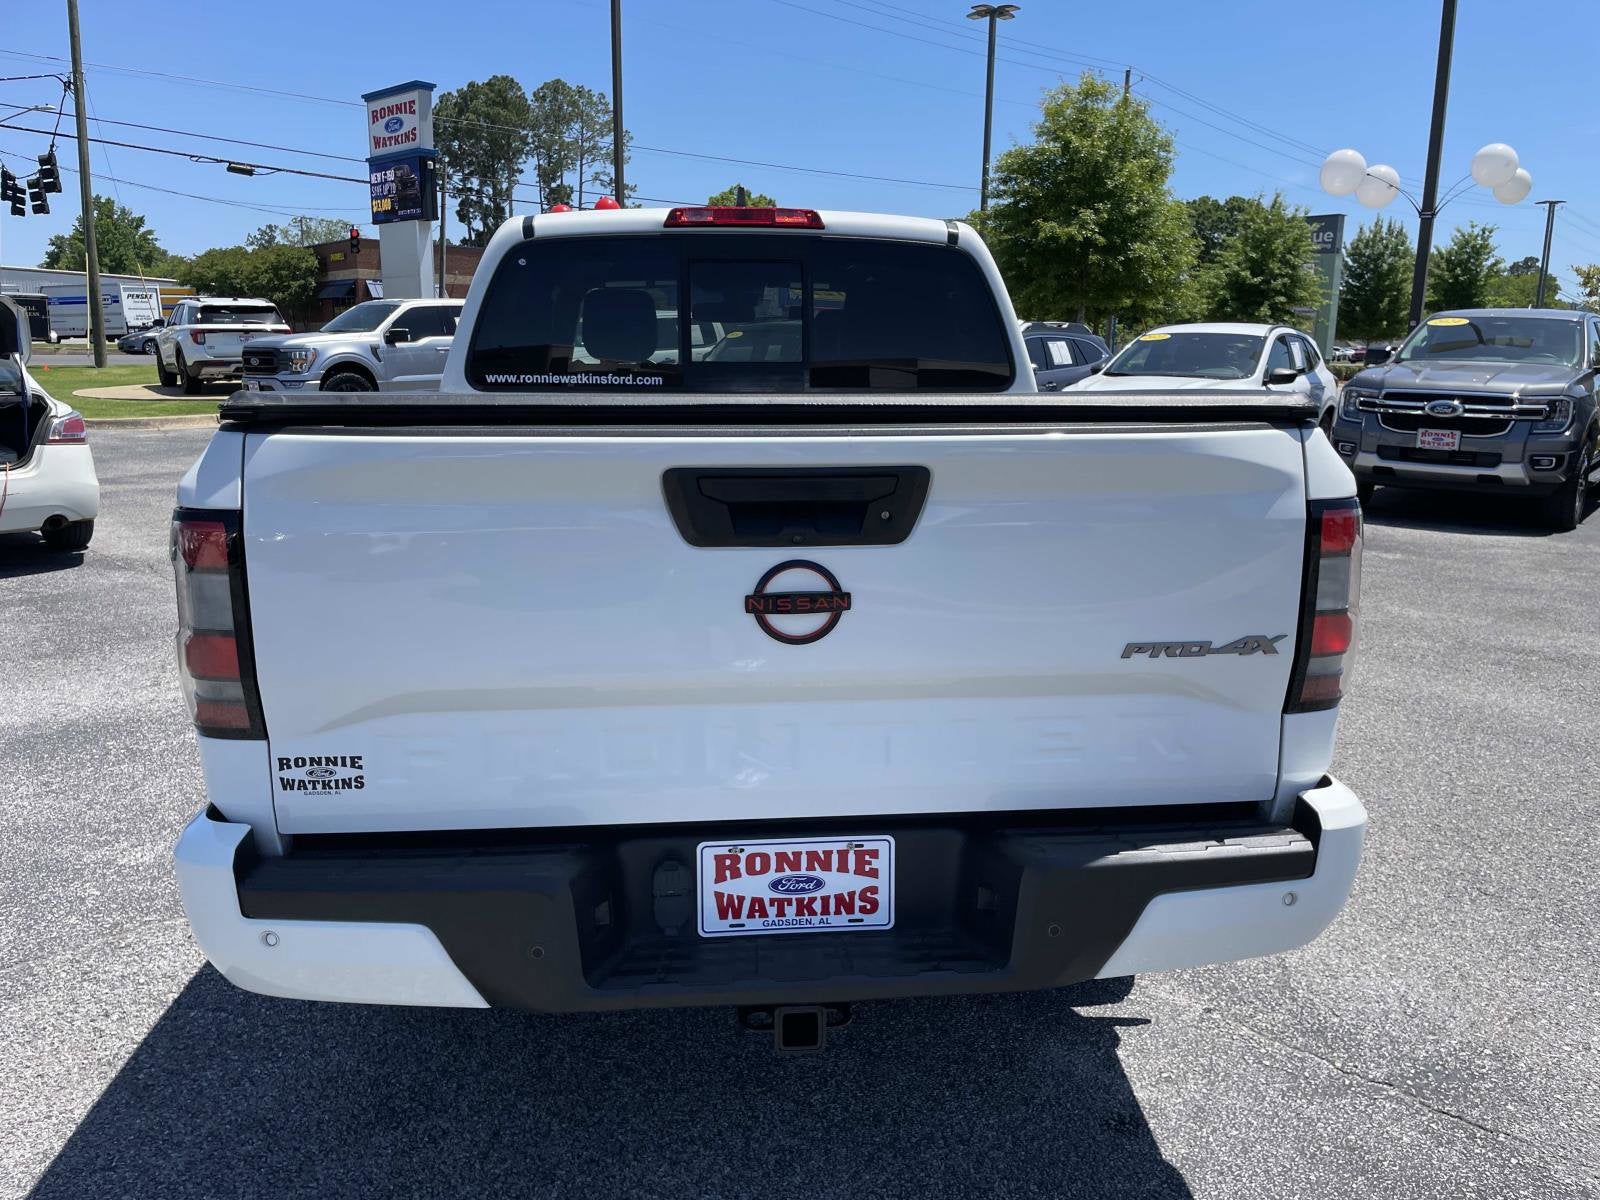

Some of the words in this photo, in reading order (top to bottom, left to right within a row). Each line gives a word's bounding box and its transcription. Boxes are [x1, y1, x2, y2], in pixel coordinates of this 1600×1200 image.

[371, 100, 416, 124] RONNIE
[373, 127, 417, 149] WATKINS
[485, 372, 663, 386] www.ronniewatkinsford.com
[748, 595, 849, 611] NISSAN
[277, 756, 363, 771] RONNIE
[279, 775, 364, 791] WATKINS
[714, 849, 879, 884] RONNIE
[778, 878, 818, 892] Ford
[714, 885, 879, 920] WATKINS
[762, 917, 815, 928] GADSDEN,
[818, 916, 832, 926] AL
